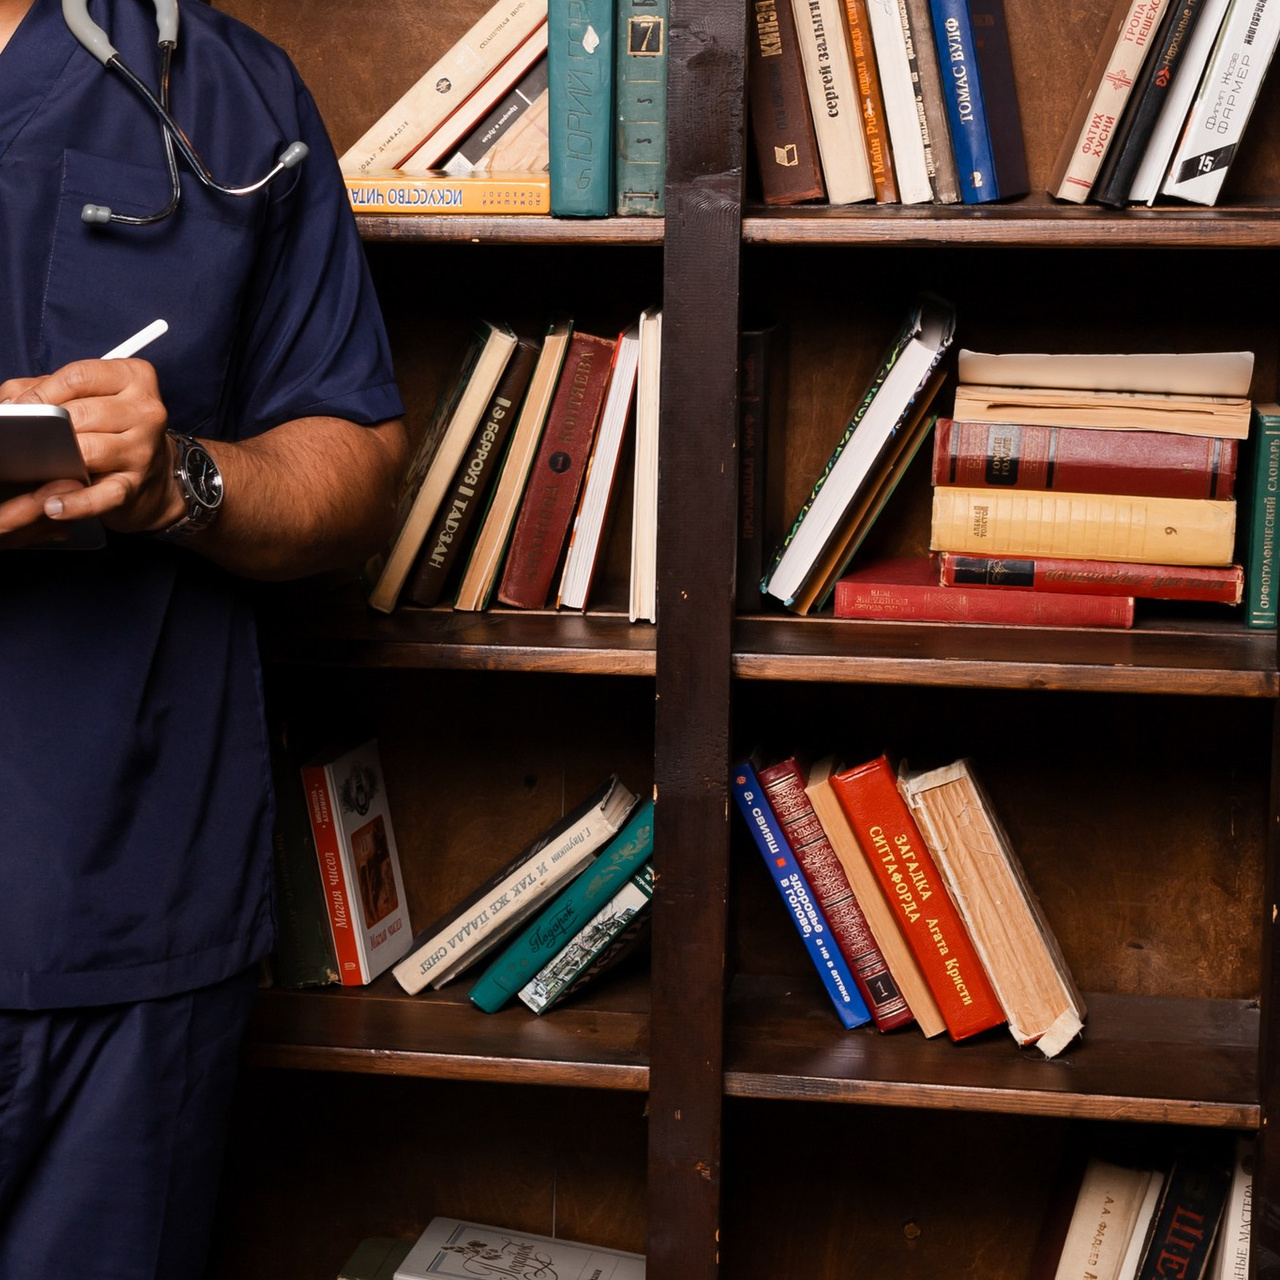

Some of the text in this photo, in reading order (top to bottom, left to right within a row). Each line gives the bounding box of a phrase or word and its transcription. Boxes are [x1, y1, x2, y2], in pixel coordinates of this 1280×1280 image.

[638, 22, 656, 52] 7
[1122, 0, 1148, 44] ТРОПА
[1162, 5, 1193, 66] Народные
[850, 27, 871, 96] ОЦЕОЛА ВОЖДЬ
[943, 15, 974, 124] ТОМАС ВУЛФ
[497, 103, 519, 126] Призрак
[566, 67, 594, 162] ЮРИЙ
[817, 63, 842, 118] сергей
[1203, 50, 1240, 131] Филип Жозе
[1215, 52, 1253, 136] ФАРМЕР
[376, 119, 410, 153] ДУМБАДЗЕ
[866, 138, 886, 175] Майн
[1080, 110, 1105, 155] ФАТИХ
[1092, 114, 1116, 158] ХУСНИ
[1194, 152, 1216, 173] 15
[388, 188, 463, 206] ИСКУССТВО
[482, 199, 540, 207] ДОМАШНИЙ
[555, 348, 596, 447] КОПТЯЕВА
[426, 494, 468, 570] ТАРЗАН
[972, 506, 982, 537] АЛЕКСЕЙ
[980, 505, 989, 538] ТОЛСТОЙ
[1257, 438, 1279, 609] ОРФОГРАФИЧЕСКИЙ СЛОВАРЬ
[547, 829, 586, 866] Паушкин
[750, 805, 780, 855] свияш
[321, 850, 349, 930] Магия чисел
[866, 822, 922, 925] СИТТАФОРДА
[892, 831, 933, 902] ЗАГАДКА
[415, 861, 550, 976] И ТАК ЖЕ ПАДАЛ СНЕГ
[523, 896, 584, 959] Подарок
[782, 887, 814, 939] голове,
[787, 871, 824, 935] здоровье
[829, 967, 852, 1004] аптеке
[924, 915, 975, 1008] Агата Кристи
[1086, 1219, 1107, 1267] ФАДЕЕВ
